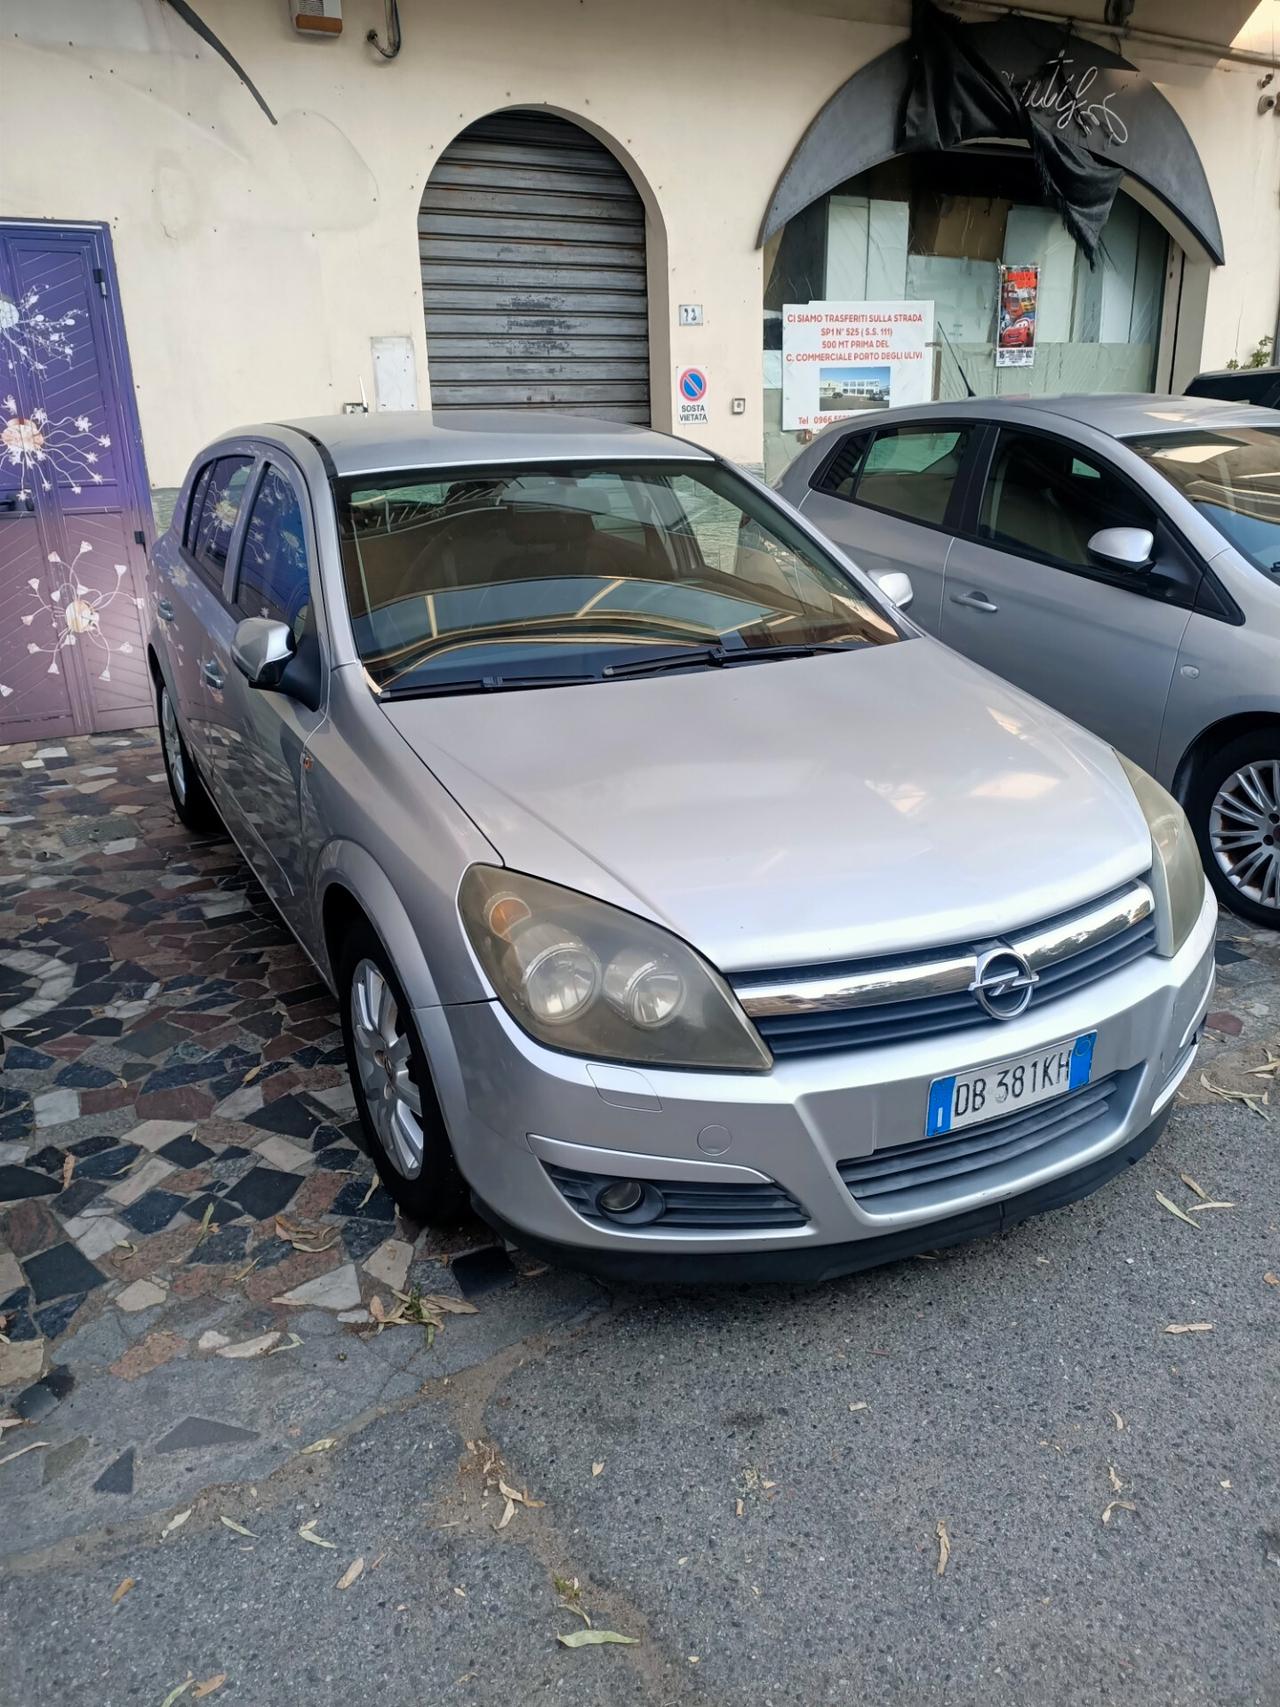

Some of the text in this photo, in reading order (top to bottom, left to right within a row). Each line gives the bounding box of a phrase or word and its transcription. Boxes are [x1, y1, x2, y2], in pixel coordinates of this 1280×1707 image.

[787, 314, 923, 322] CI SIAMO TRASFERITI SULLA STRADA
[821, 328, 835, 336] SP1
[846, 328, 860, 336] 525
[822, 341, 837, 349] 500
[851, 340, 874, 348] PRIMA
[876, 340, 890, 348] DEL
[786, 351, 923, 362] C. COMMERCIALE PORTO DEGLI ULIVI
[681, 405, 705, 413] SOSTA
[680, 413, 708, 422] VIETATA
[798, 416, 809, 425] Tel
[954, 1078, 987, 1117] DB
[995, 1050, 1072, 1103] 381KH
